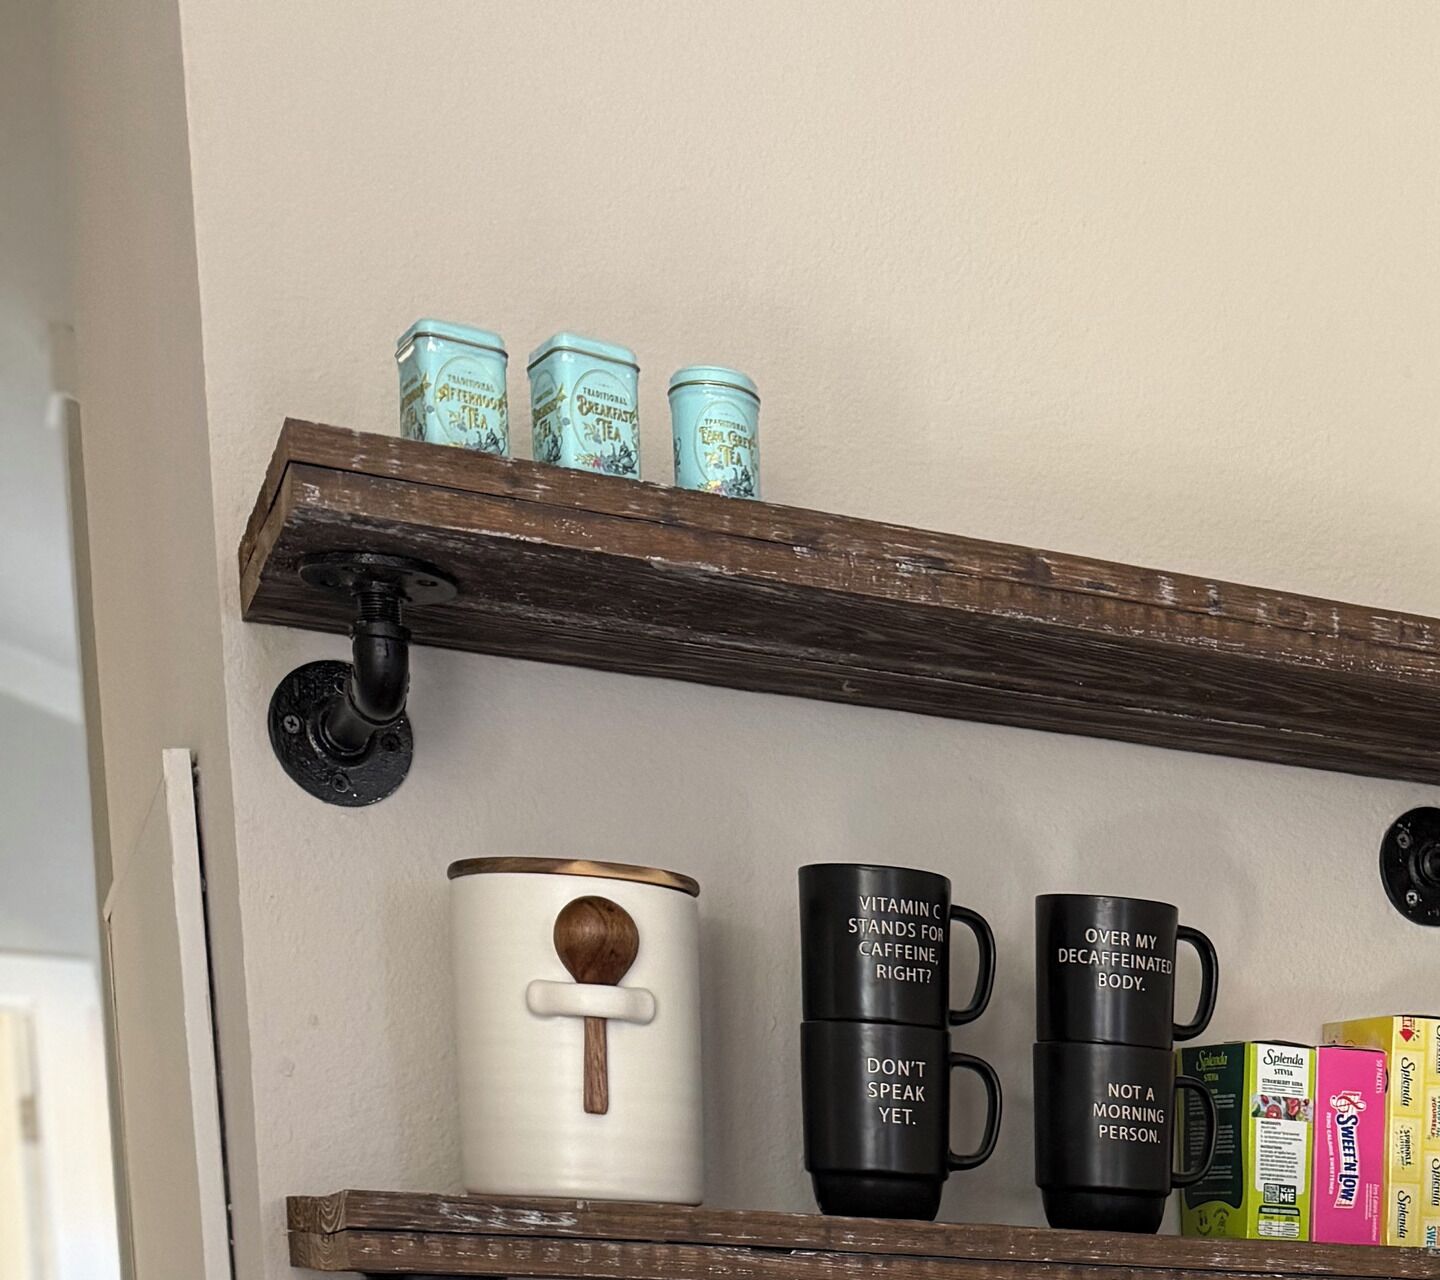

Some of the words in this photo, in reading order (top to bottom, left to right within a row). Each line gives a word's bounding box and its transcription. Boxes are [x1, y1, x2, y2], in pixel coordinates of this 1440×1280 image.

[583, 386, 628, 406] TRADITIONAL
[461, 404, 489, 431] TEA
[576, 394, 634, 424] BREAKFAST
[595, 417, 622, 443] TEA
[717, 444, 743, 468] TEA
[859, 895, 929, 918] VITAMIN
[933, 904, 941, 920] C
[848, 918, 916, 938] STANDS
[921, 924, 944, 943] FOR
[1085, 927, 1131, 947] OVER
[1135, 932, 1157, 950] MY
[858, 941, 939, 966] CAFFEINE,
[1057, 947, 1173, 975] DECAFFEINATED
[876, 963, 932, 984] RIGHT?
[1097, 972, 1146, 992] BODY.
[866, 1056, 926, 1078] DON'T
[1263, 1048, 1304, 1067] Splenda
[867, 1080, 926, 1103] SPEAK
[1108, 1082, 1140, 1100] NOT
[1145, 1084, 1155, 1101] A
[1401, 1057, 1415, 1107] Splenda
[878, 1107, 917, 1126] YET.
[1092, 1103, 1165, 1124] MORNING
[1098, 1123, 1161, 1144] PERSON.
[1280, 1193, 1295, 1203] ME
[1338, 1173, 1359, 1202] LOW
[1398, 1190, 1411, 1239] Splenda
